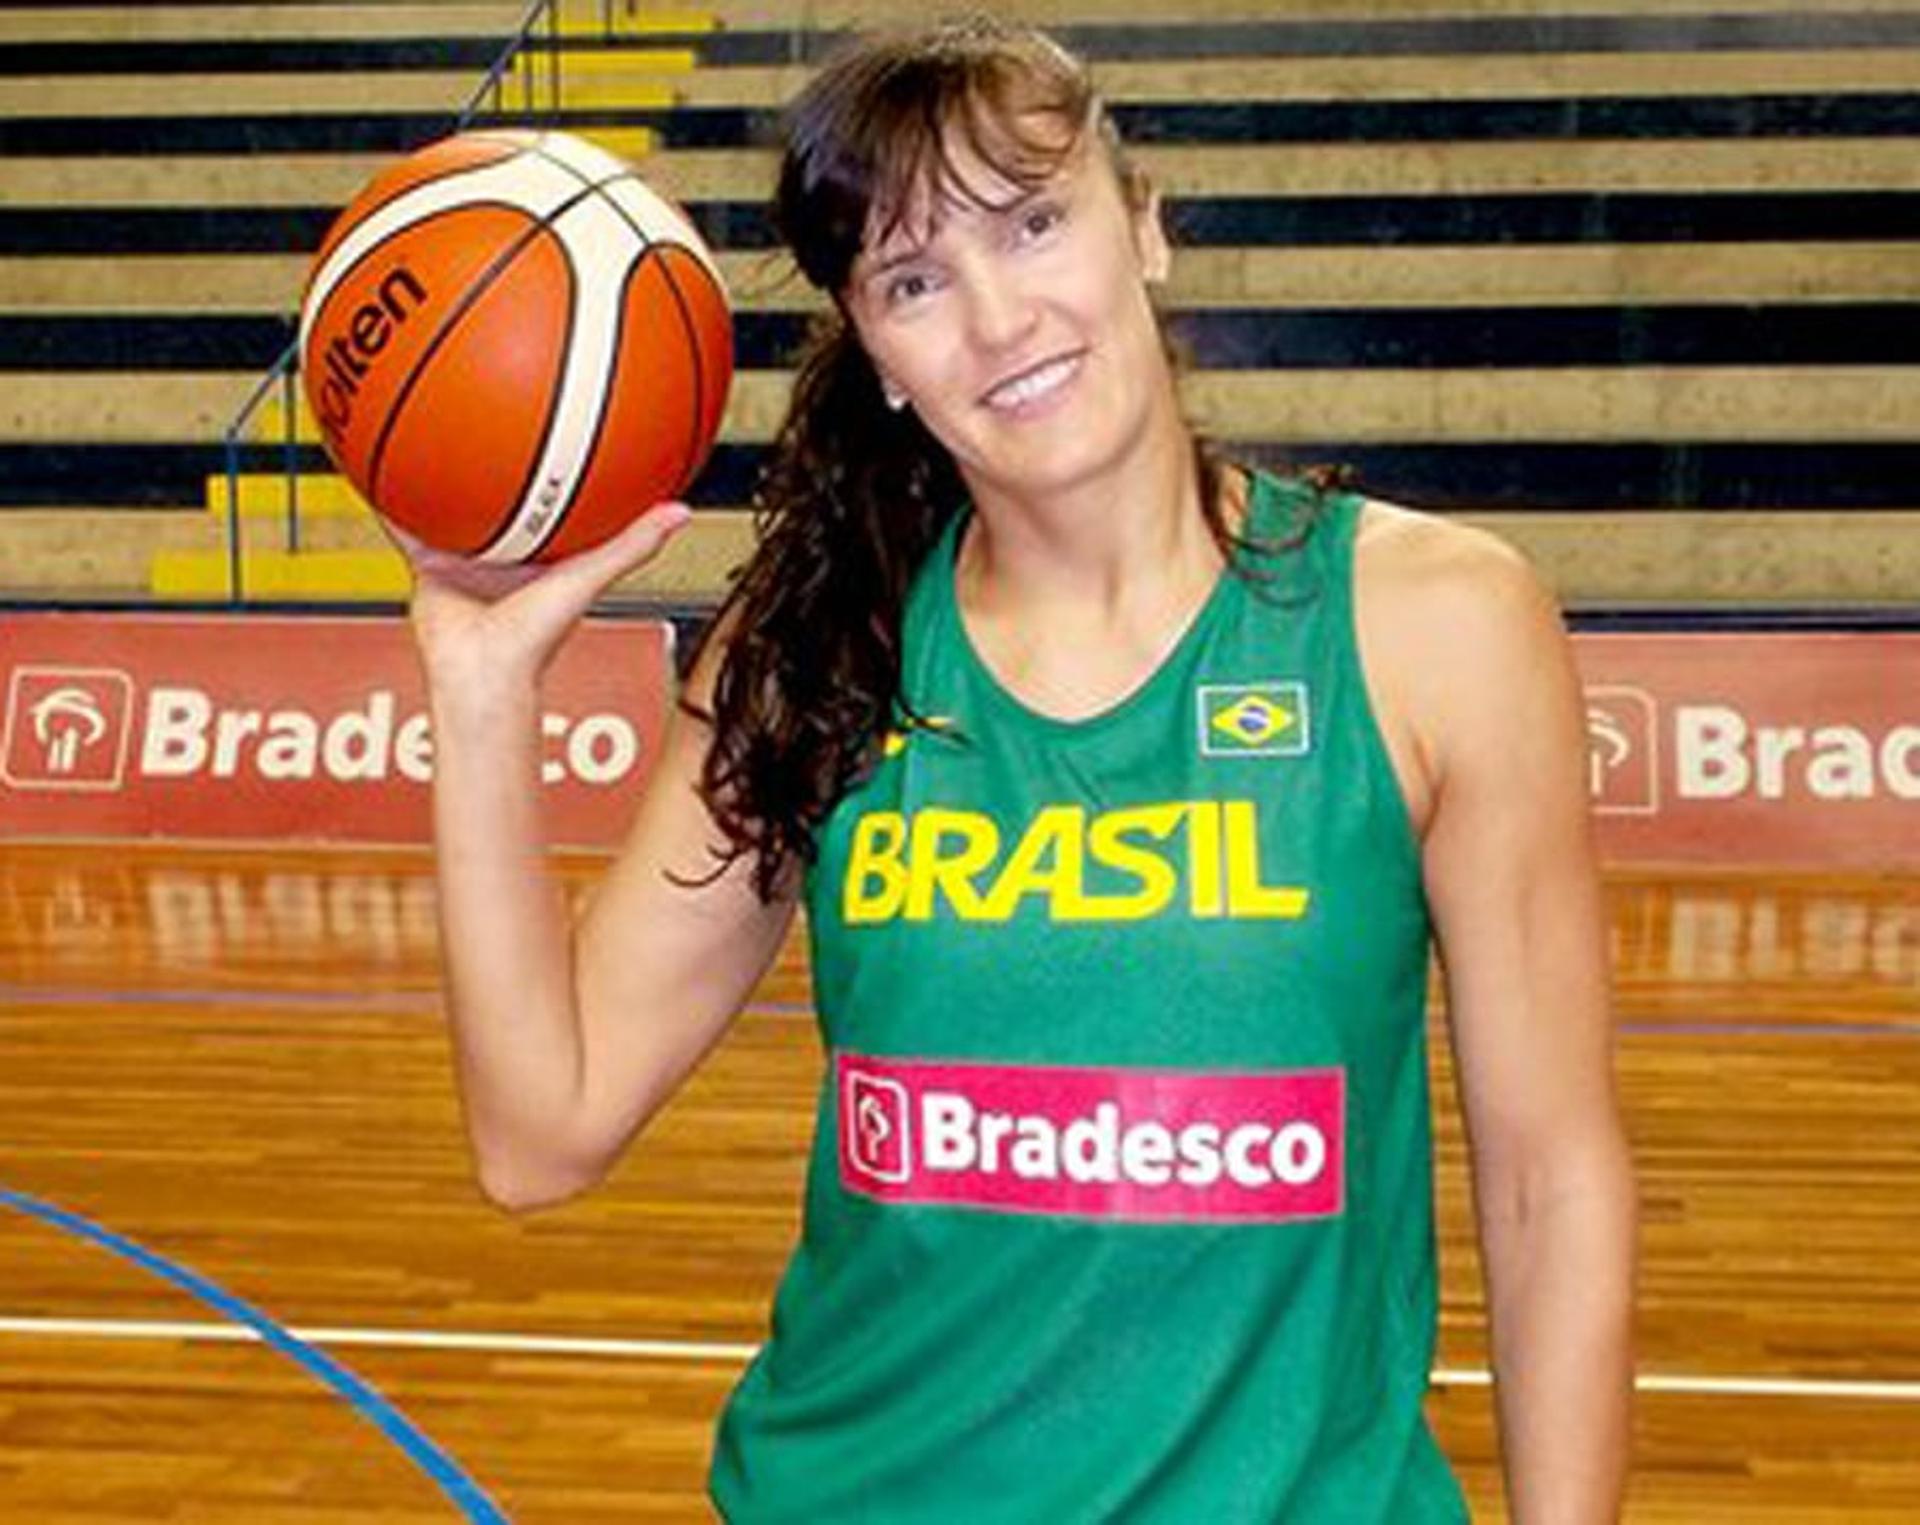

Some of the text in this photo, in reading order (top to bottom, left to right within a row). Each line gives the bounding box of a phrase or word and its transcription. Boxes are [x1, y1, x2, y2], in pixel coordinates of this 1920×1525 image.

[141, 687, 640, 784] Bradeo
[842, 801, 1310, 924] BRASIL
[920, 1092, 1325, 1186] Bradesco
